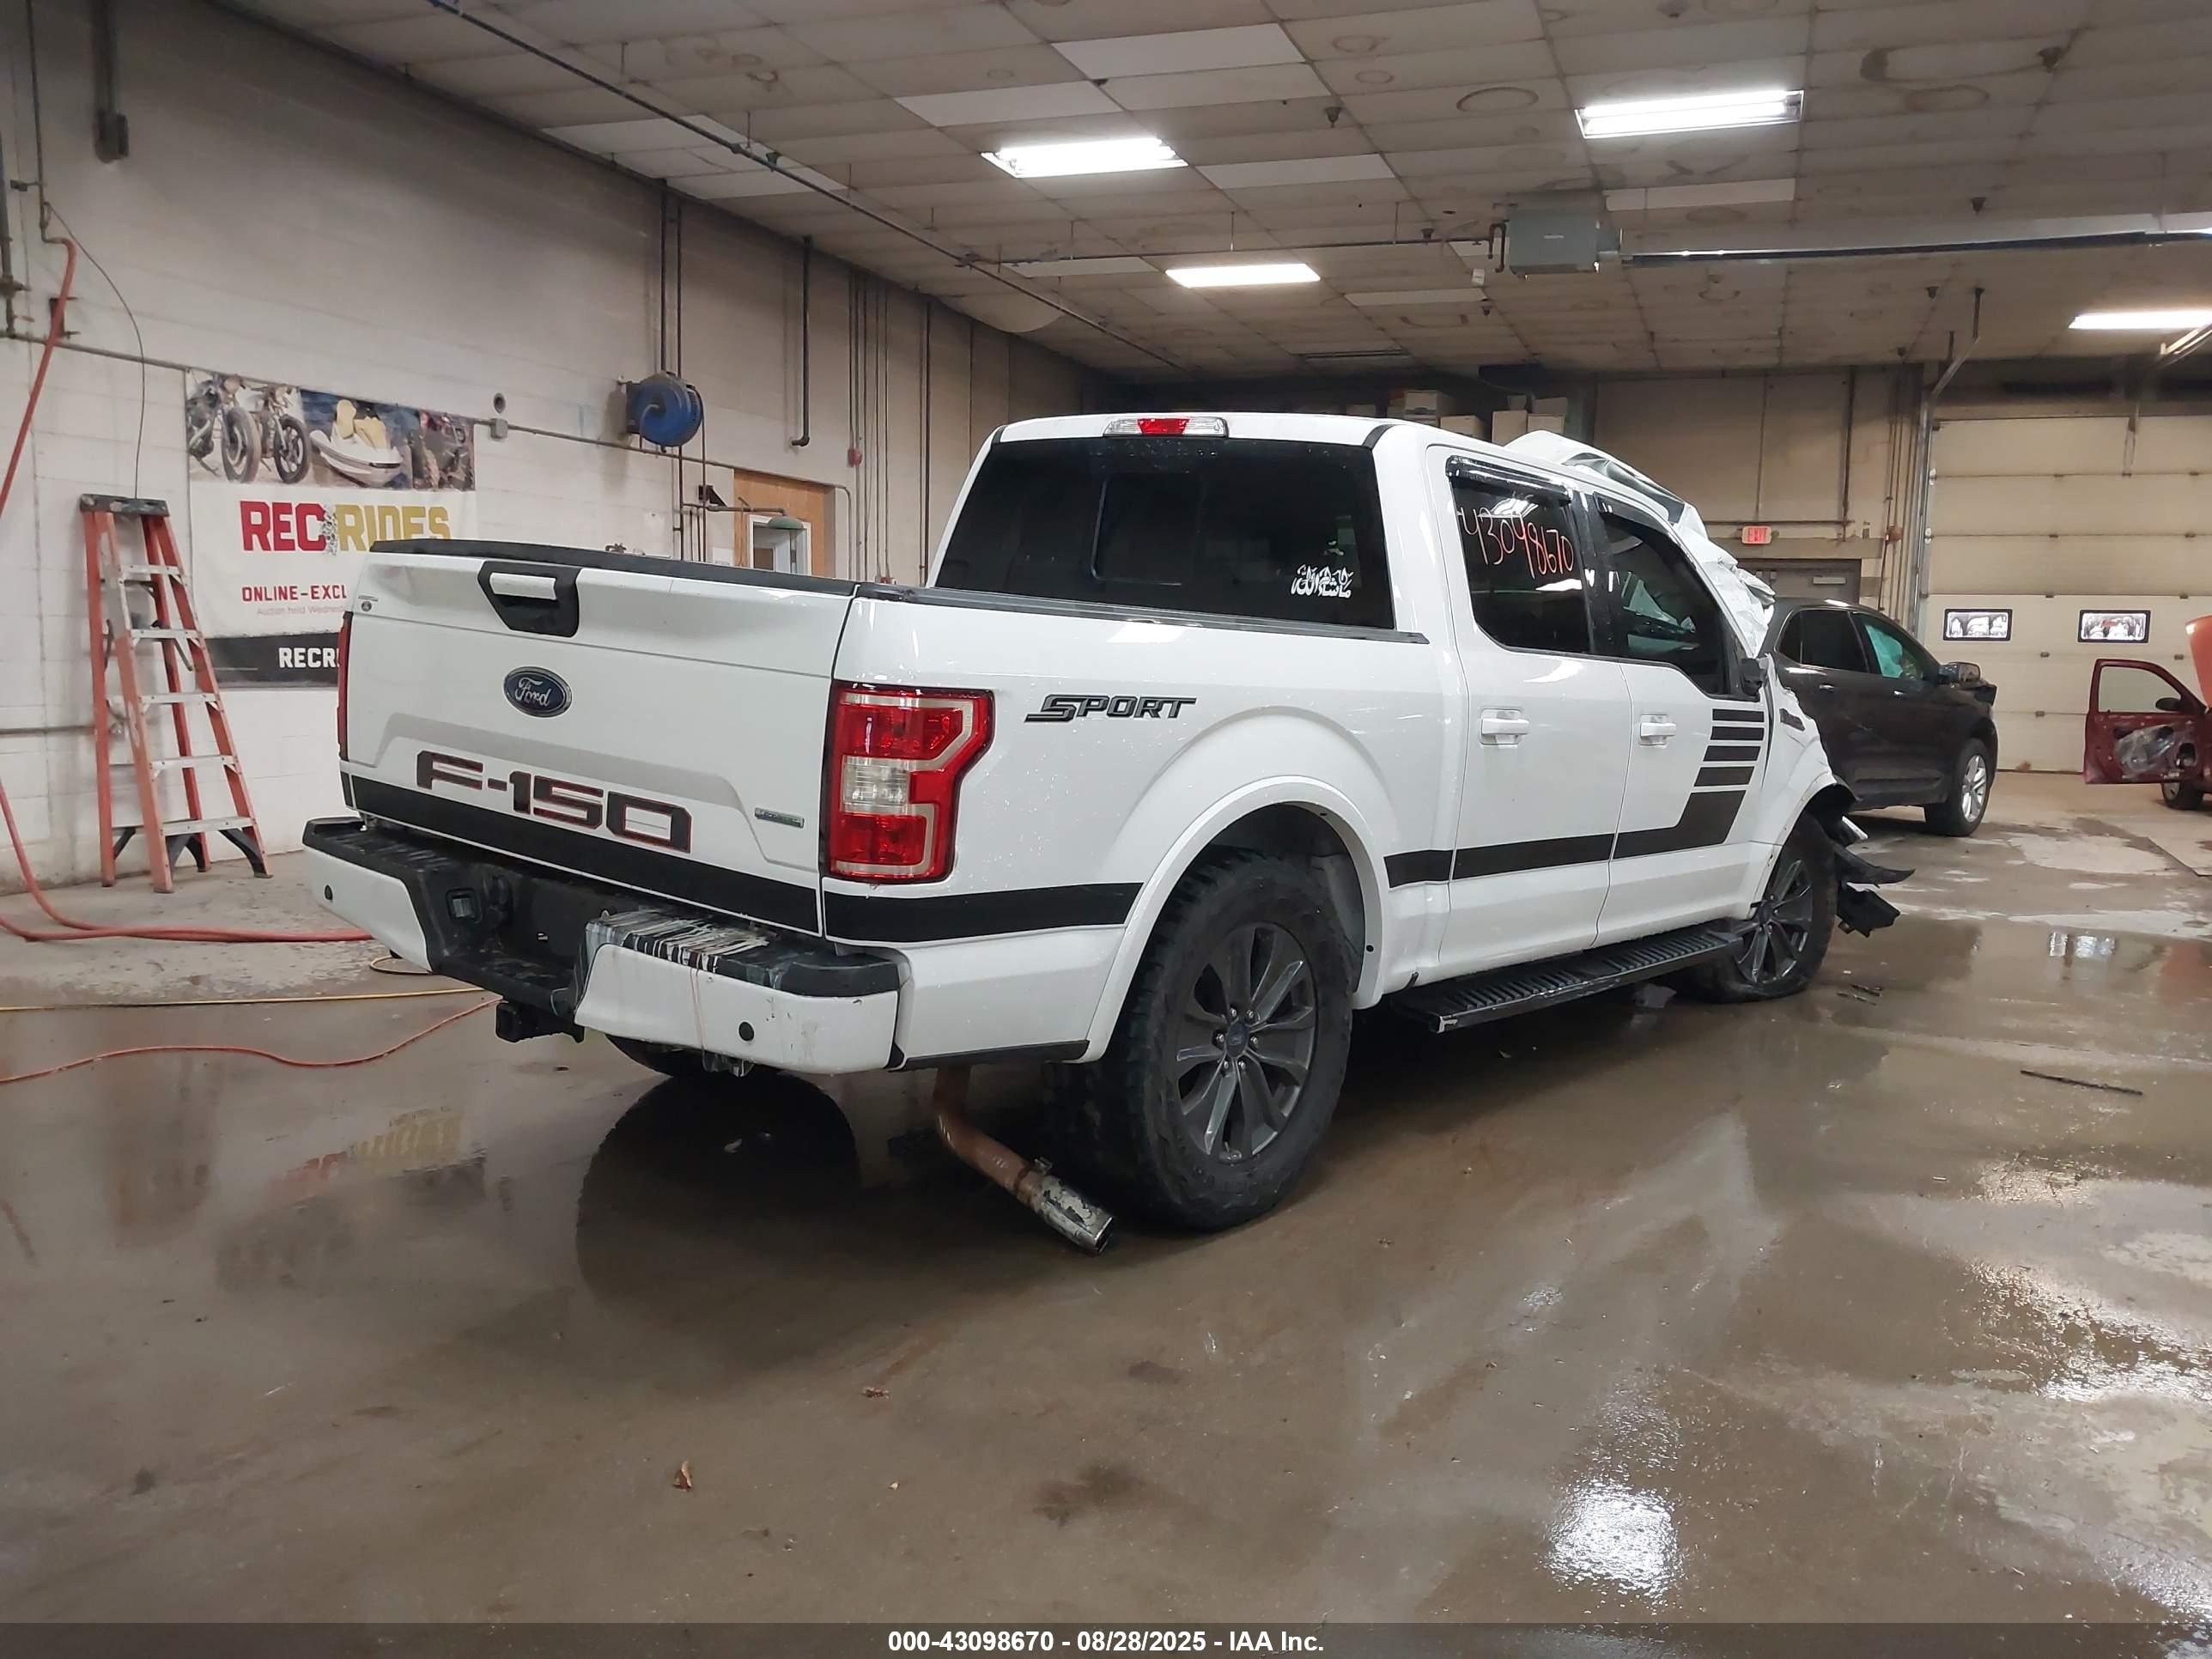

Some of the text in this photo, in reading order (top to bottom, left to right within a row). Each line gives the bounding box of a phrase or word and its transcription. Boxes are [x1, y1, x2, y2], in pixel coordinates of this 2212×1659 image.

[240, 501, 452, 551] REC RIDES
[1460, 507, 1574, 579] 43098670
[514, 677, 552, 707] Ford
[1024, 694, 1197, 722] SPORT
[416, 750, 692, 854] F-150
